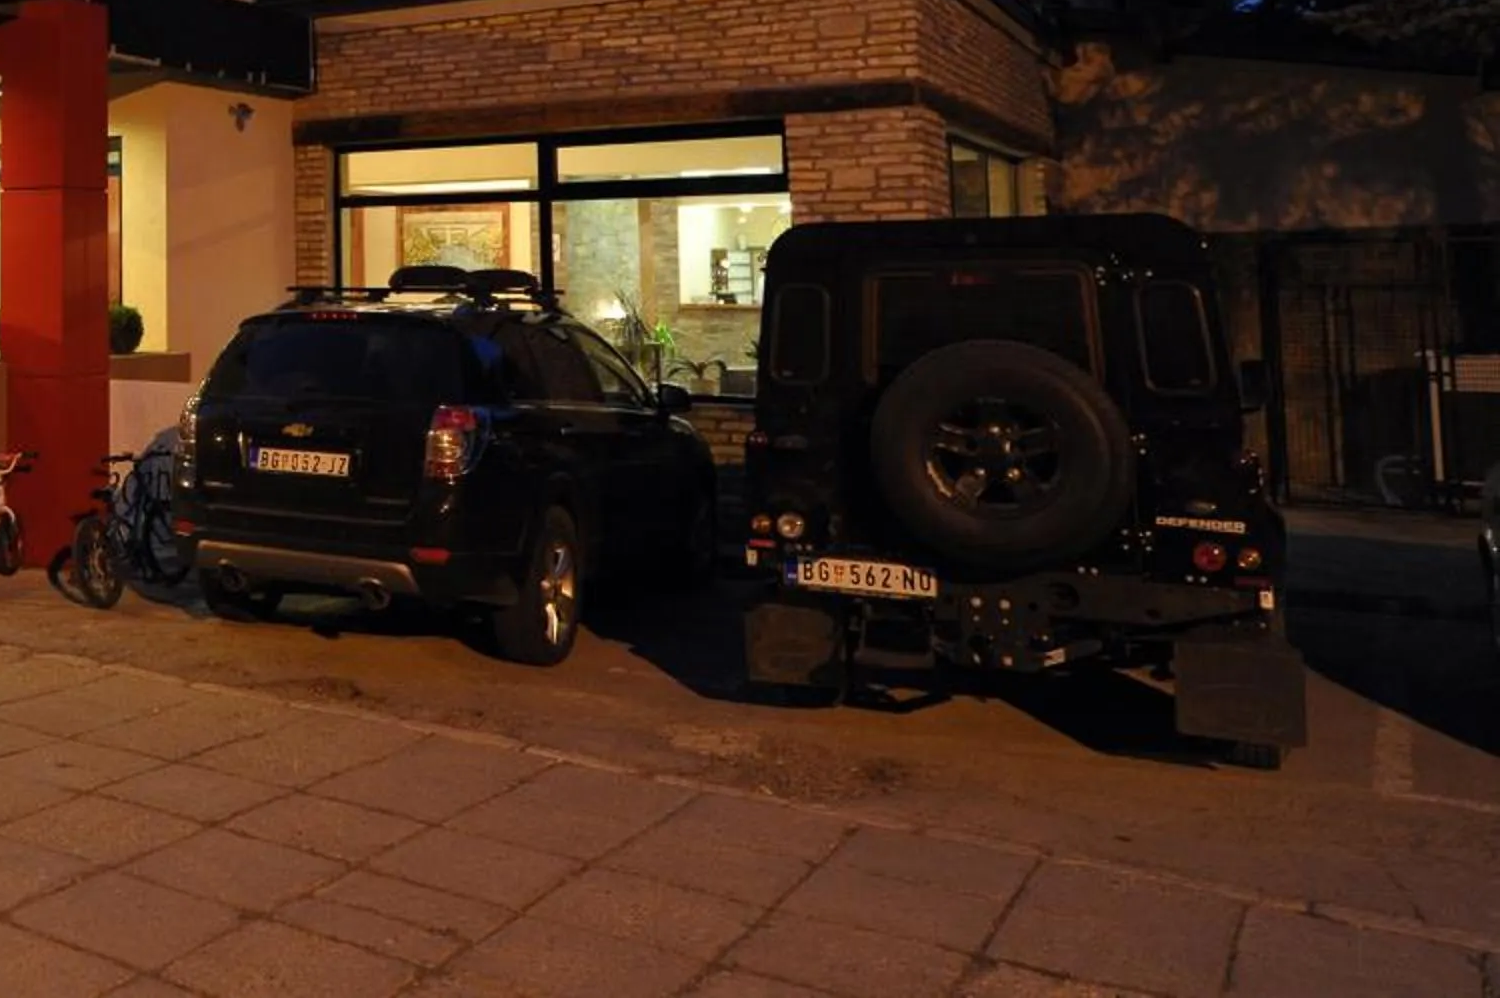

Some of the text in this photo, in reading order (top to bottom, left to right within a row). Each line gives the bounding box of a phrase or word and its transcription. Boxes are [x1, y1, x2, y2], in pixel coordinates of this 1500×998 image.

[260, 451, 280, 468] BG
[1155, 516, 1247, 534] DEFENDER
[802, 559, 830, 583] BG
